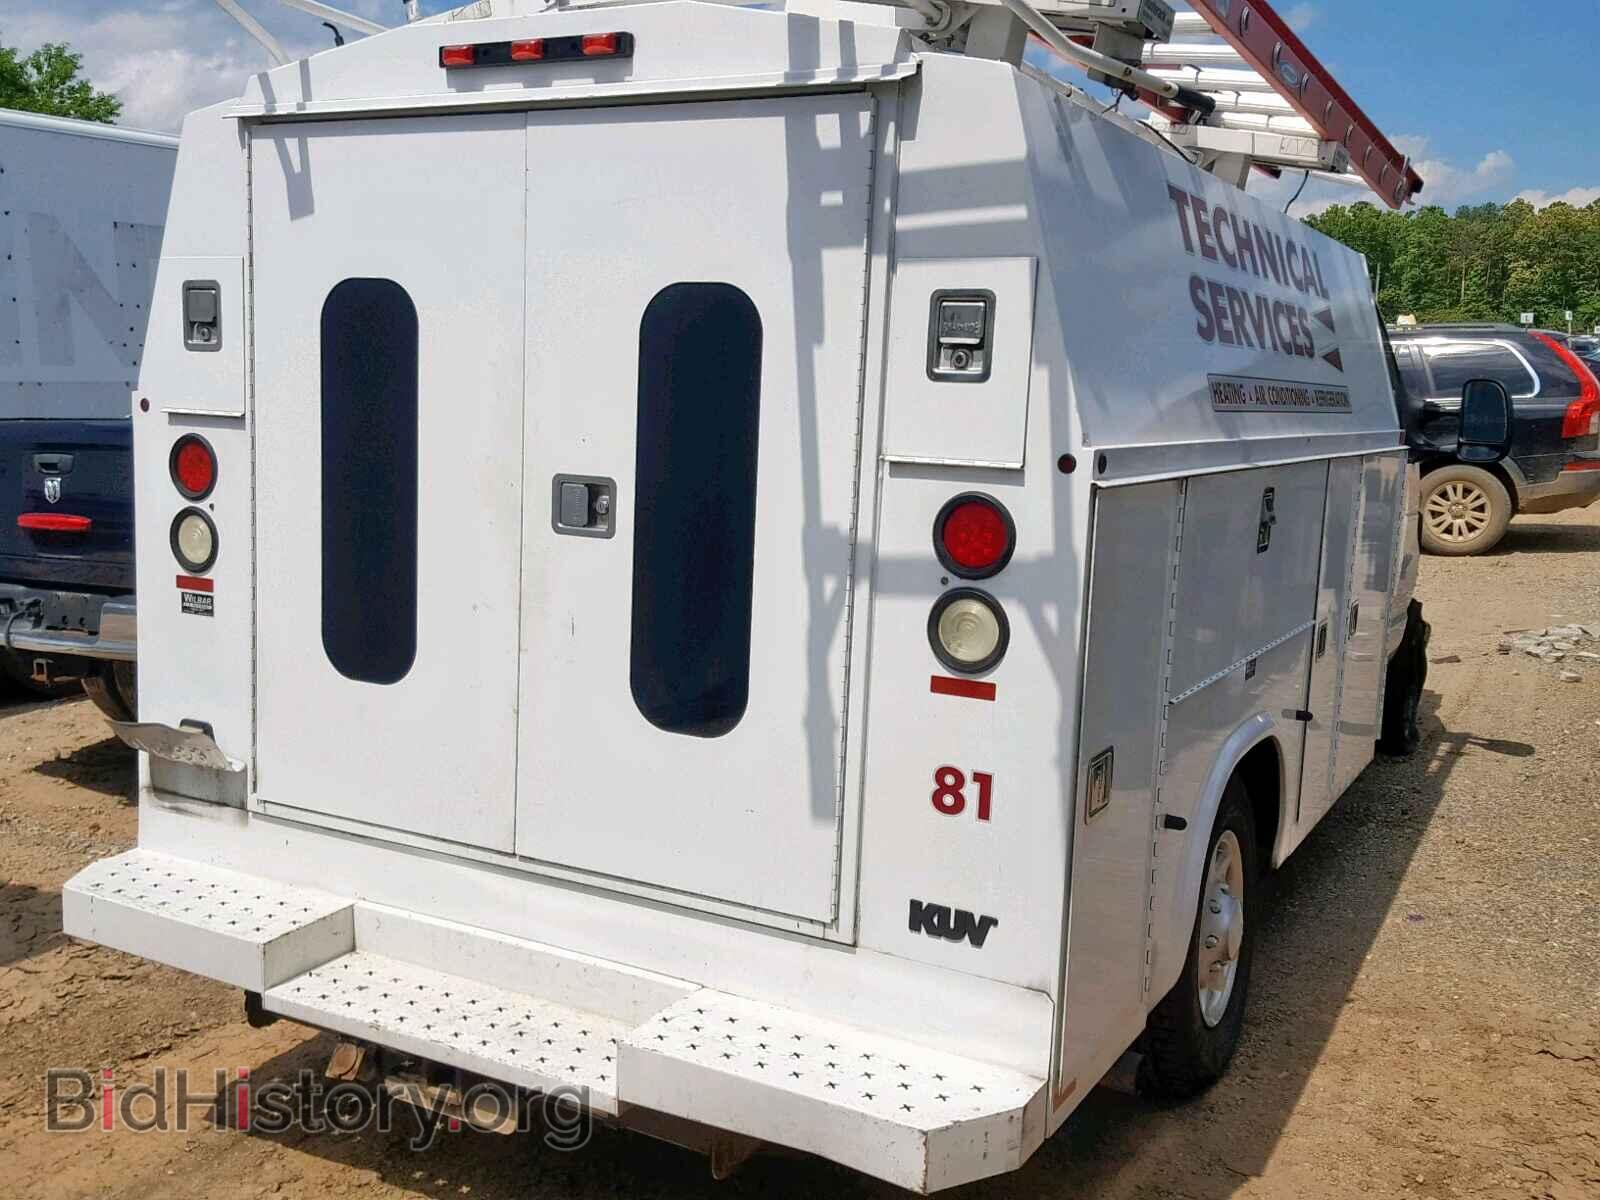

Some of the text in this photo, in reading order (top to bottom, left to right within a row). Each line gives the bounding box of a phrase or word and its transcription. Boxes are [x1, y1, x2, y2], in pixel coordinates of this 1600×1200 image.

[1167, 184, 1329, 299] TECHNICAL
[1189, 276, 1316, 358] SERVICES
[1212, 381, 1247, 405] HEATING
[931, 766, 994, 822] 81
[908, 899, 998, 948] KUV
